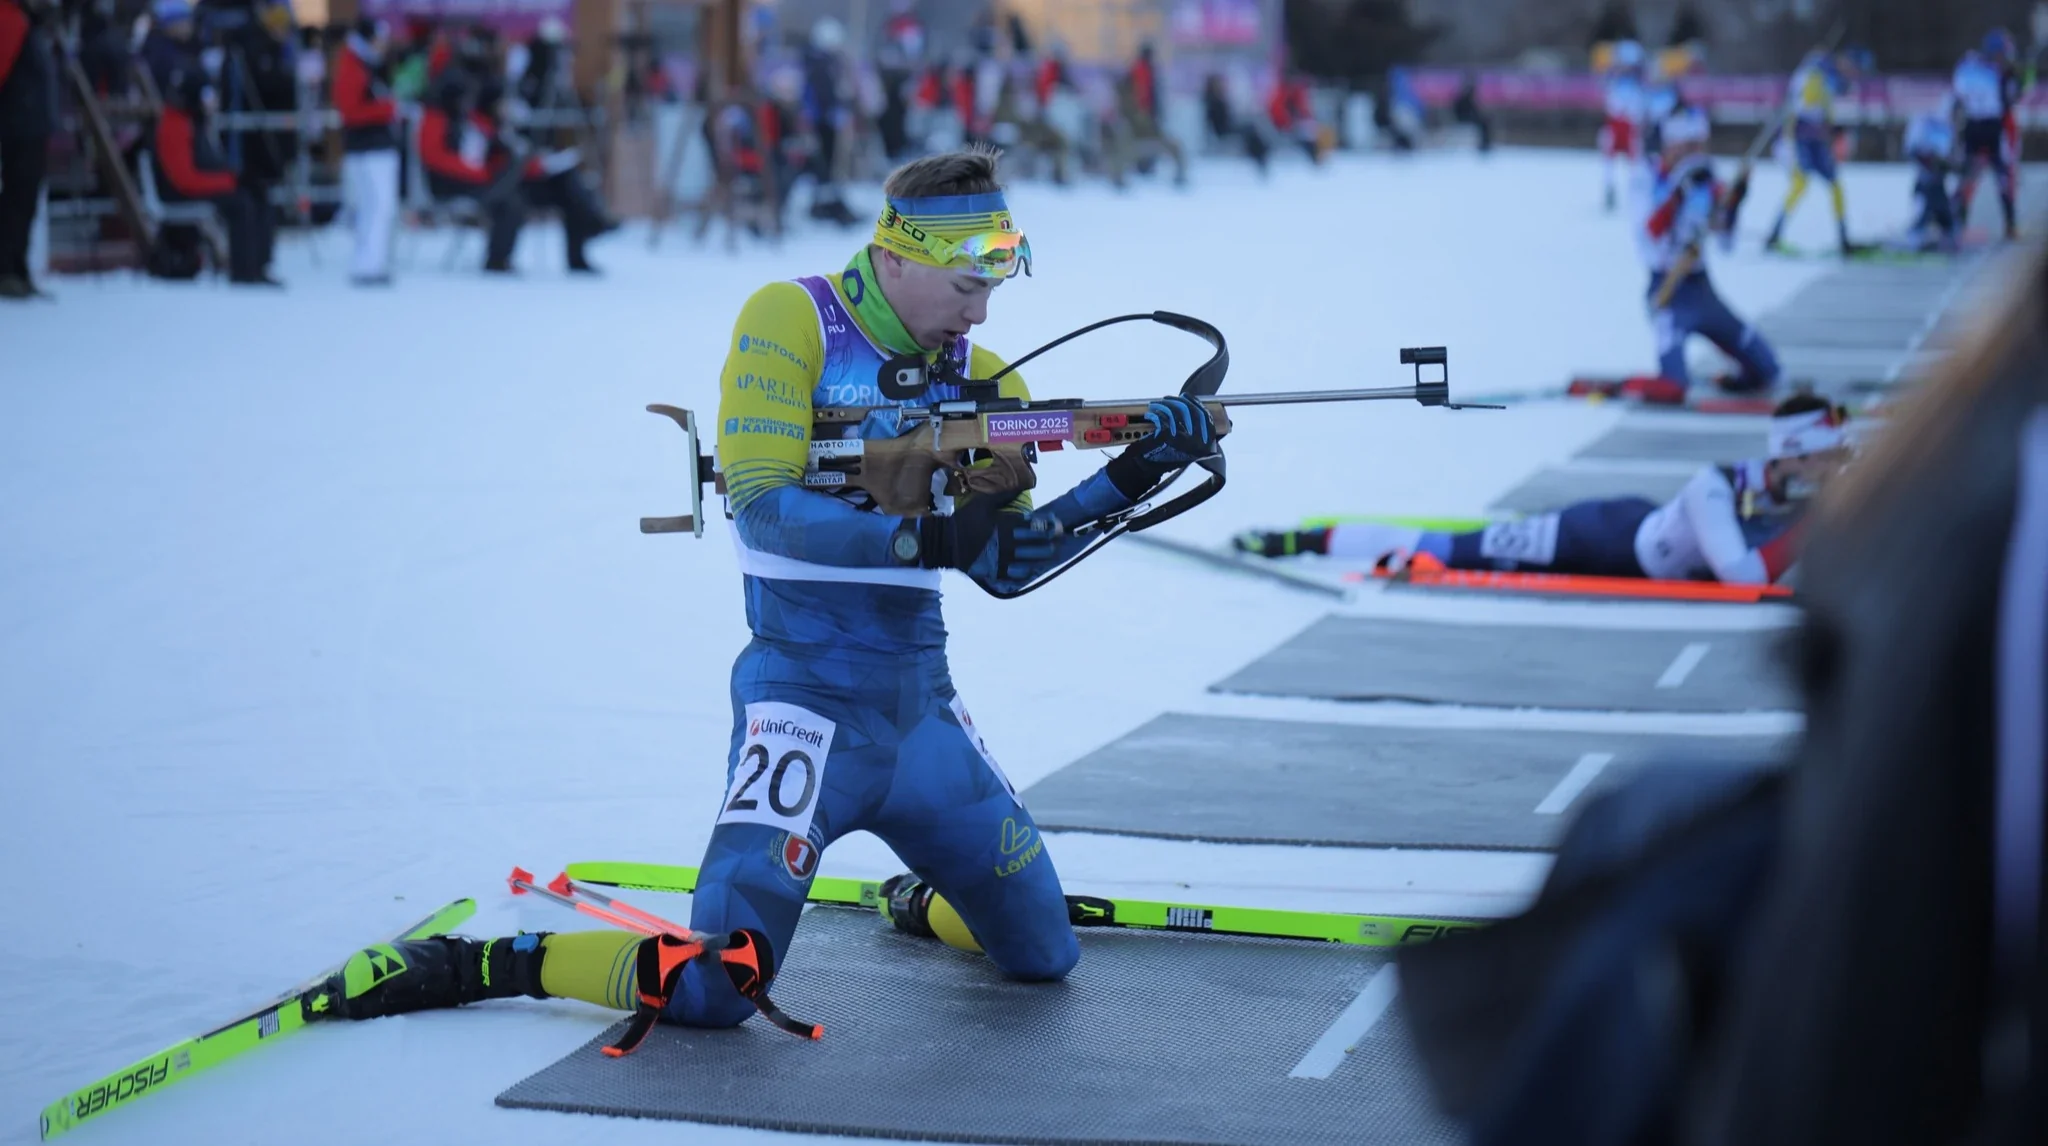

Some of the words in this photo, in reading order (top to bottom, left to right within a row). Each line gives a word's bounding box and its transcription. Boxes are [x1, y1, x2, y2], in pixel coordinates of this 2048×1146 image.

[742, 423, 805, 441] КАПІТАЛ
[989, 418, 1038, 431] TORINO
[1040, 417, 1069, 429] 2025
[811, 441, 860, 449] НАФТОГАЗ
[807, 477, 843, 485] КАПІТАЛ
[761, 719, 823, 748] UniCredit
[726, 744, 816, 818] 20
[994, 836, 1042, 878] Löffle
[77, 1057, 168, 1119] FISCHER
